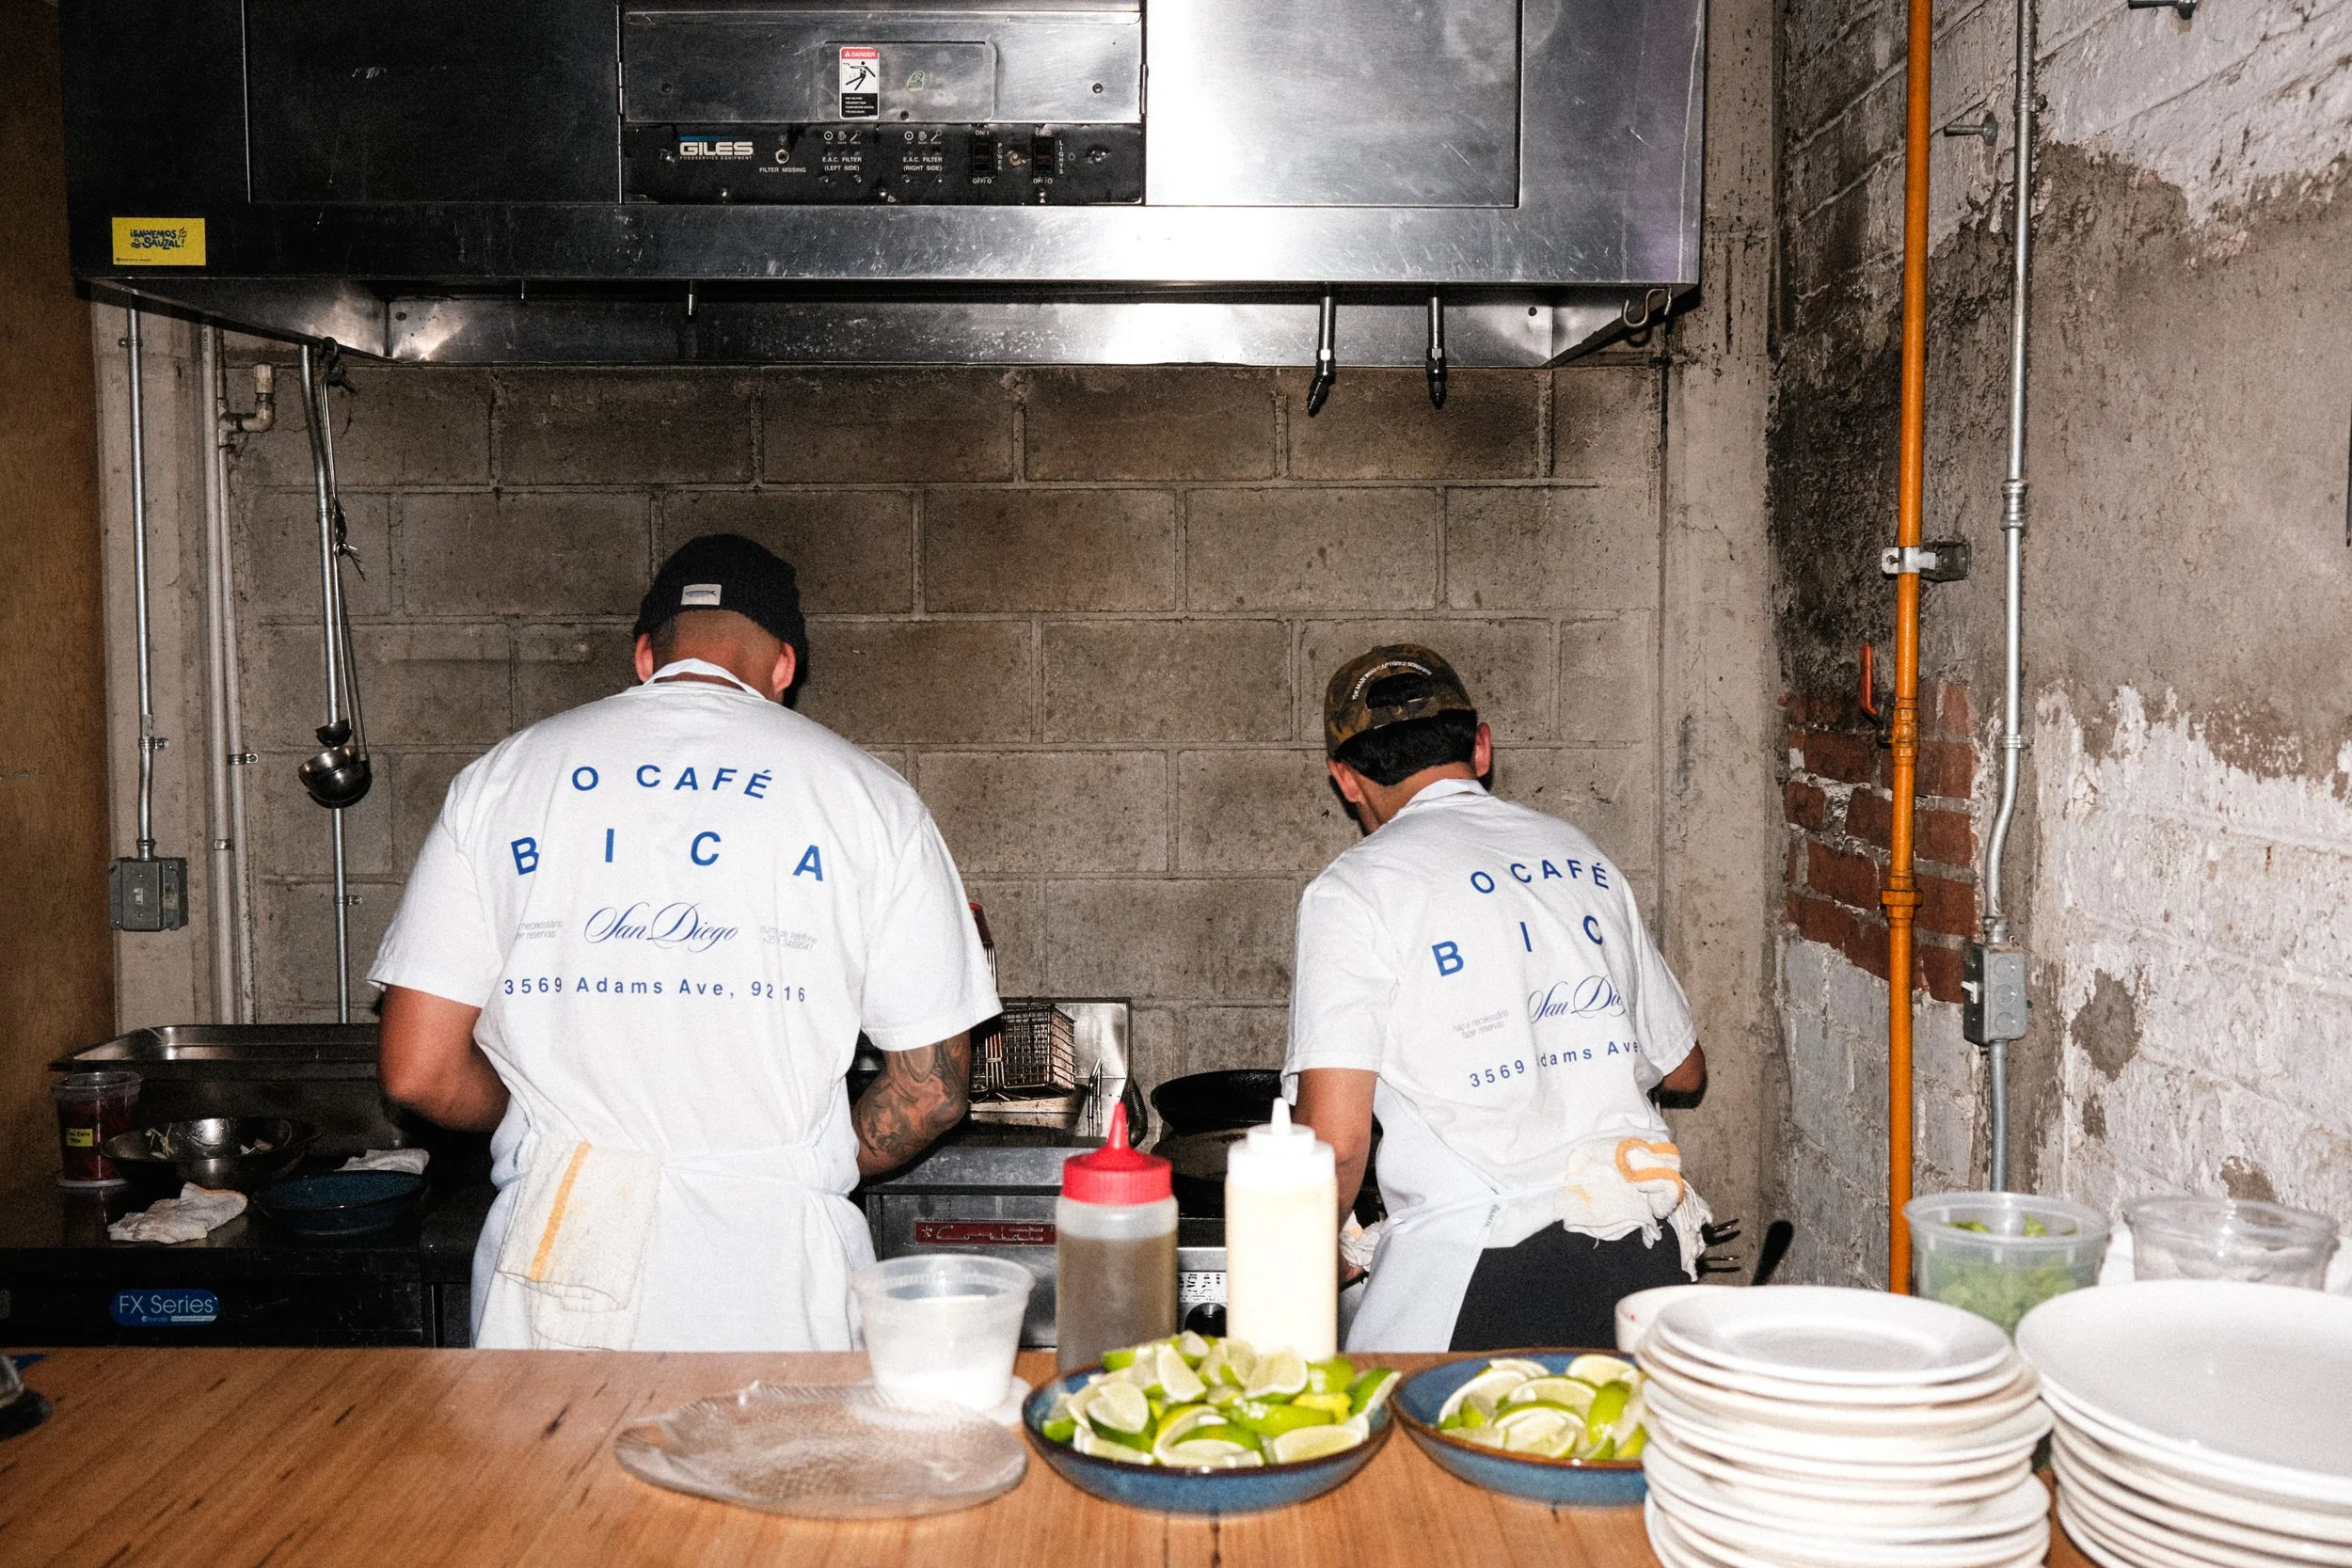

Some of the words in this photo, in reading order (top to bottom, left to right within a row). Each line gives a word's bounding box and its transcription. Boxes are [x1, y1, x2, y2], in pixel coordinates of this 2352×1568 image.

[679, 141, 754, 156] GILES
[572, 767, 599, 791] O
[636, 764, 773, 800] CAFÉ
[1470, 871, 1495, 894] O
[1510, 859, 1609, 890] CAFÉ
[583, 901, 651, 944] San
[646, 901, 739, 954] Diego
[504, 977, 563, 995] 3569
[576, 976, 663, 994] Adams
[678, 978, 735, 999] Ave,
[1527, 980, 1568, 1023] San
[1469, 1059, 1525, 1087] 3569
[1537, 1048, 1593, 1068] dams
[119, 1295, 144, 1314] FX
[151, 1294, 214, 1314] Series
